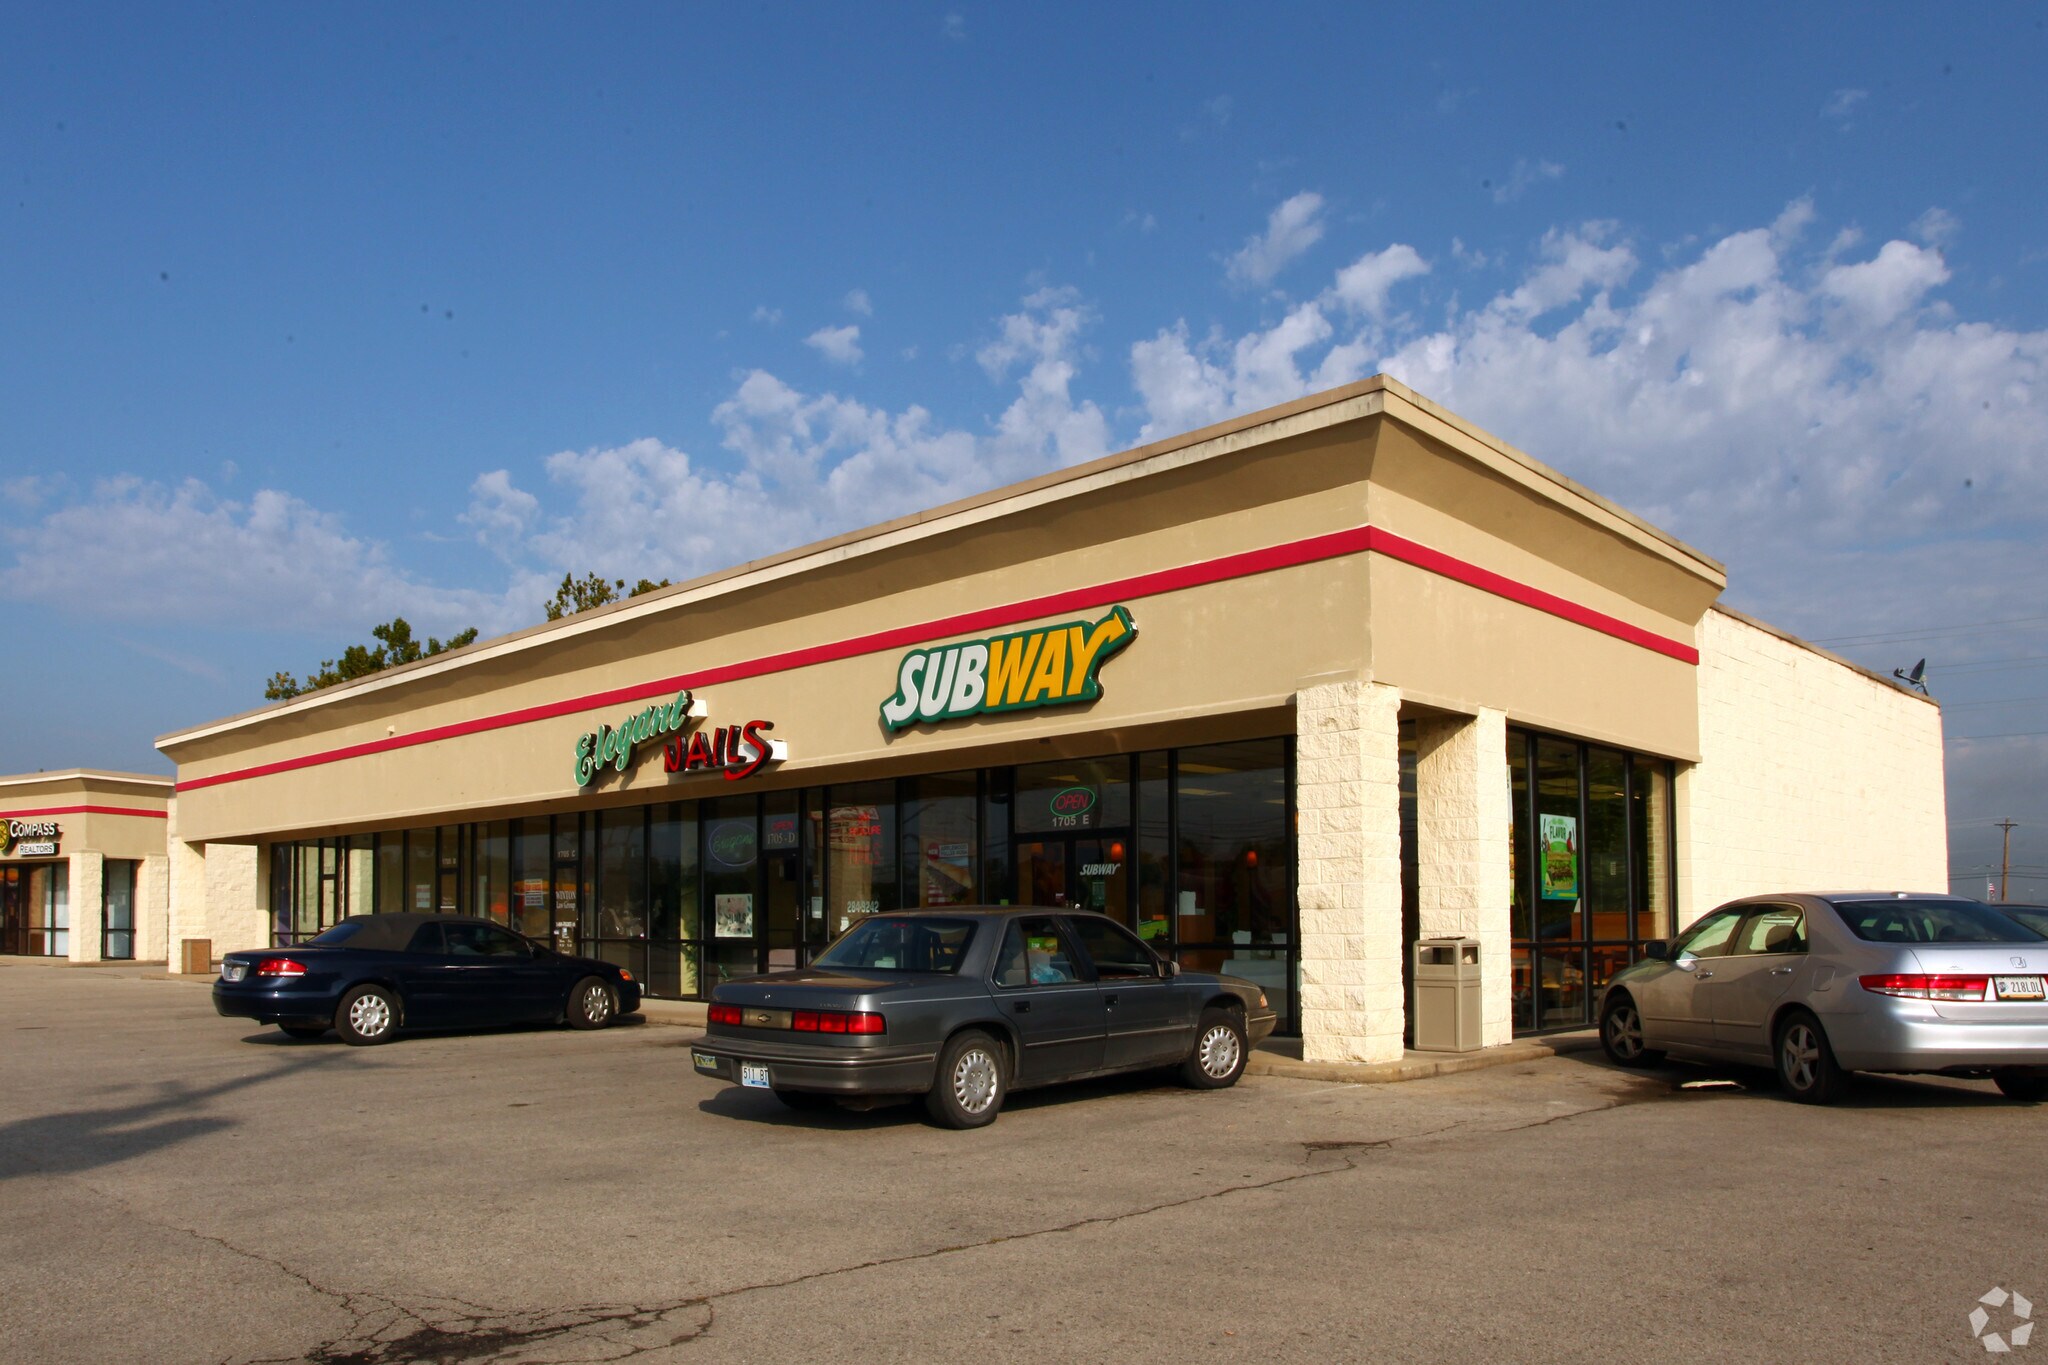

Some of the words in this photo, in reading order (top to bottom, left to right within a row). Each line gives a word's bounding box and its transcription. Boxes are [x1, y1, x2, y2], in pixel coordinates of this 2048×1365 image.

[882, 613, 1127, 726] SUBWAY
[574, 690, 688, 787] Elegant
[664, 720, 768, 781] NAILS
[1056, 794, 1089, 810] OPEN
[1052, 815, 1077, 827] 1705
[1082, 814, 1090, 825] E
[20, 844, 53, 853] REALTORS
[1079, 863, 1121, 876] SUBWAY
